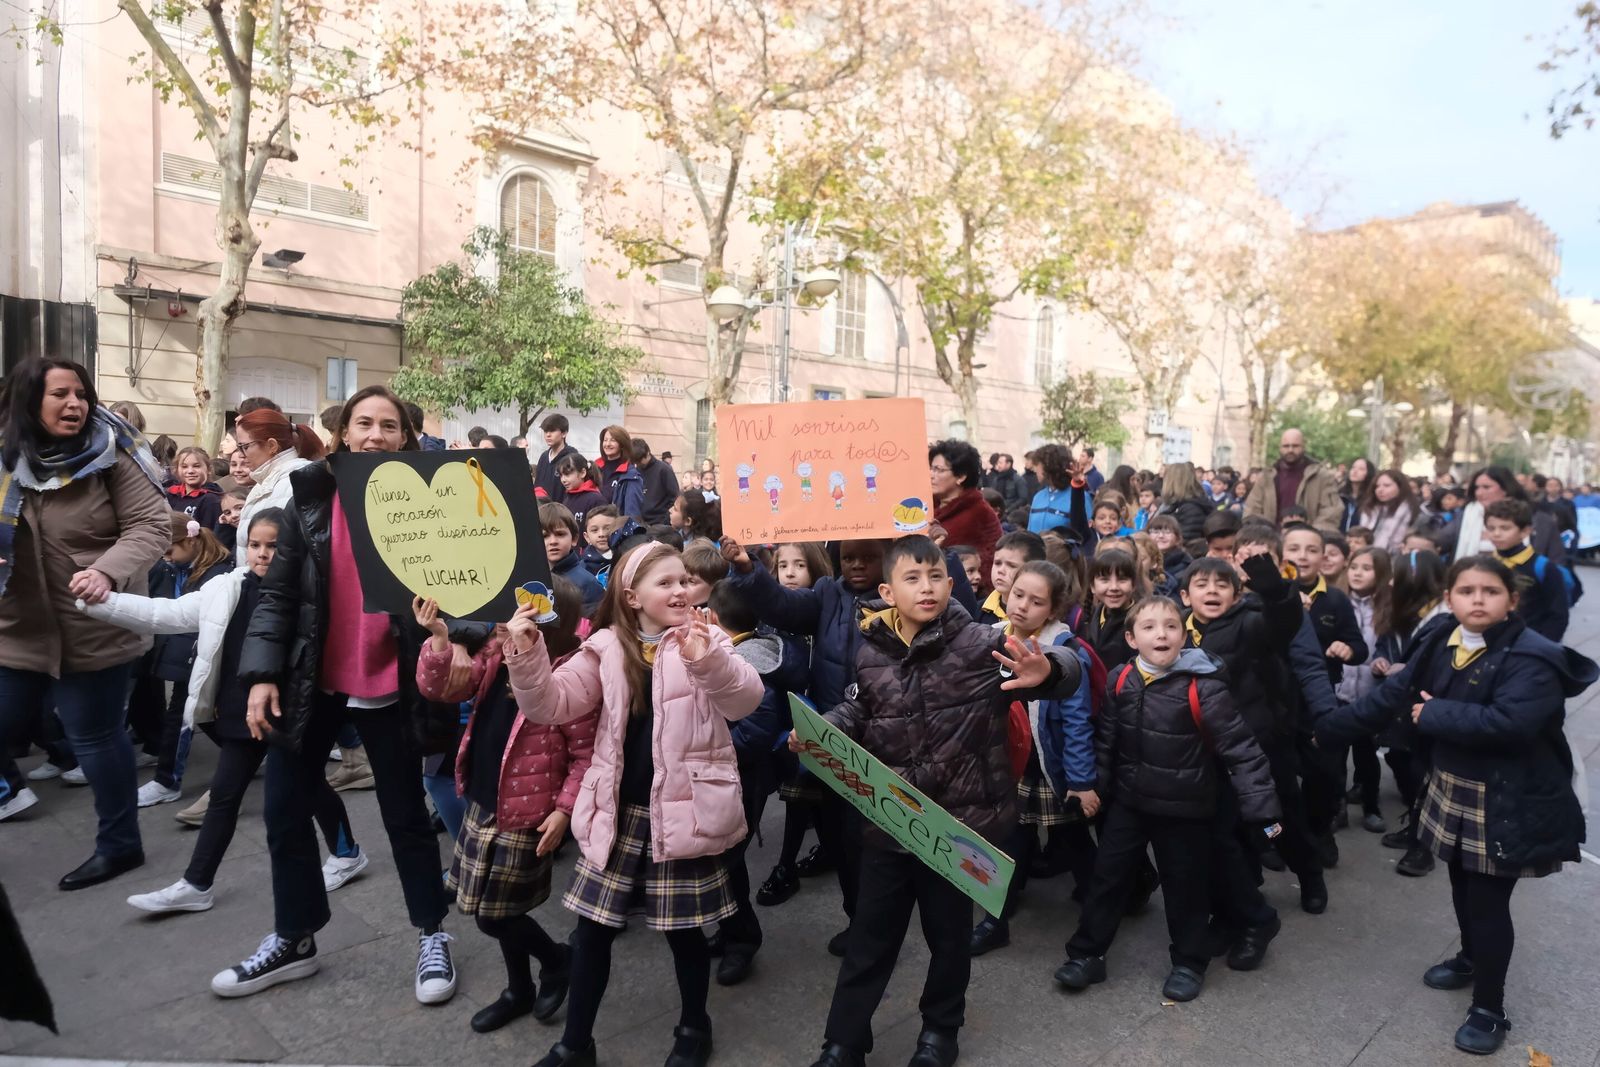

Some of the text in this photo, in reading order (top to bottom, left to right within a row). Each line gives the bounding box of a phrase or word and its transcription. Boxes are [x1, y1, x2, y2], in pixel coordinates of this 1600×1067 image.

[729, 414, 880, 442] Mil sonrisas
[789, 440, 910, 473] para tod@s
[435, 484, 457, 499] un
[386, 505, 447, 525] corazón
[380, 523, 501, 552] guerrero diseñado
[739, 527, 753, 540] 15
[760, 529, 768, 539] de
[773, 527, 799, 540] febrero
[401, 554, 434, 572] para
